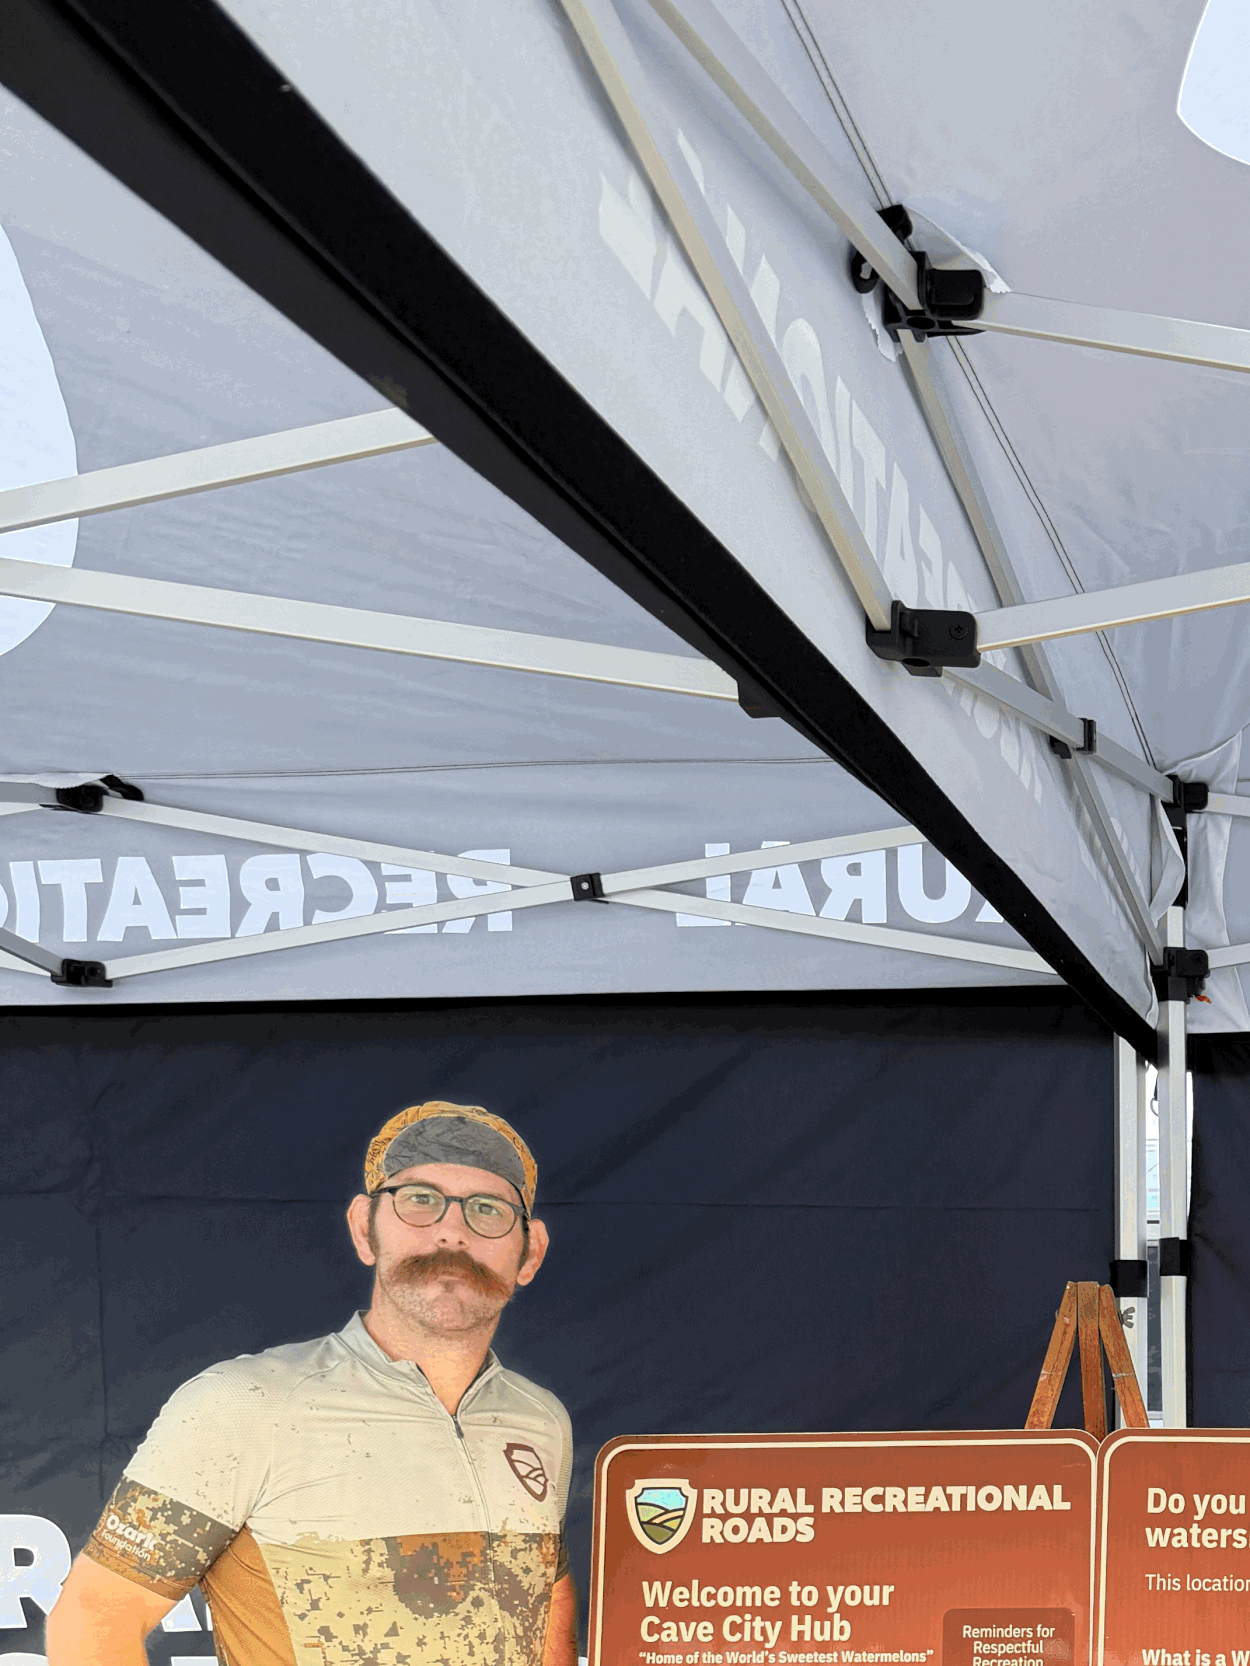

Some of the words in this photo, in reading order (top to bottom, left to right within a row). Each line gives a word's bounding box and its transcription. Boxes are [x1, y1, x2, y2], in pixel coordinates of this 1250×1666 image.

[701, 1487, 814, 1514] RURAL
[821, 1484, 1071, 1513] RECREATIONAL
[1147, 1487, 1185, 1513] Do
[1192, 1493, 1245, 1520] you
[107, 1515, 157, 1551] Ozark
[701, 1516, 814, 1543] ROADS
[102, 1529, 152, 1561] Foundation
[641, 1579, 780, 1608] Welcome
[788, 1580, 818, 1607] to
[825, 1585, 894, 1613] your
[1144, 1573, 1181, 1591] This
[640, 1615, 713, 1642] Cave
[722, 1613, 782, 1648] City
[790, 1614, 852, 1642] Hub
[962, 1623, 1033, 1638] Reminders
[1036, 1623, 1055, 1637] for
[685, 1651, 699, 1664] of
[701, 1651, 723, 1663] the
[778, 1650, 838, 1663] Sweetest
[973, 1640, 1043, 1656] Respectful
[1141, 1647, 1191, 1666] What
[1195, 1648, 1210, 1666] is
[1214, 1653, 1226, 1666] a
